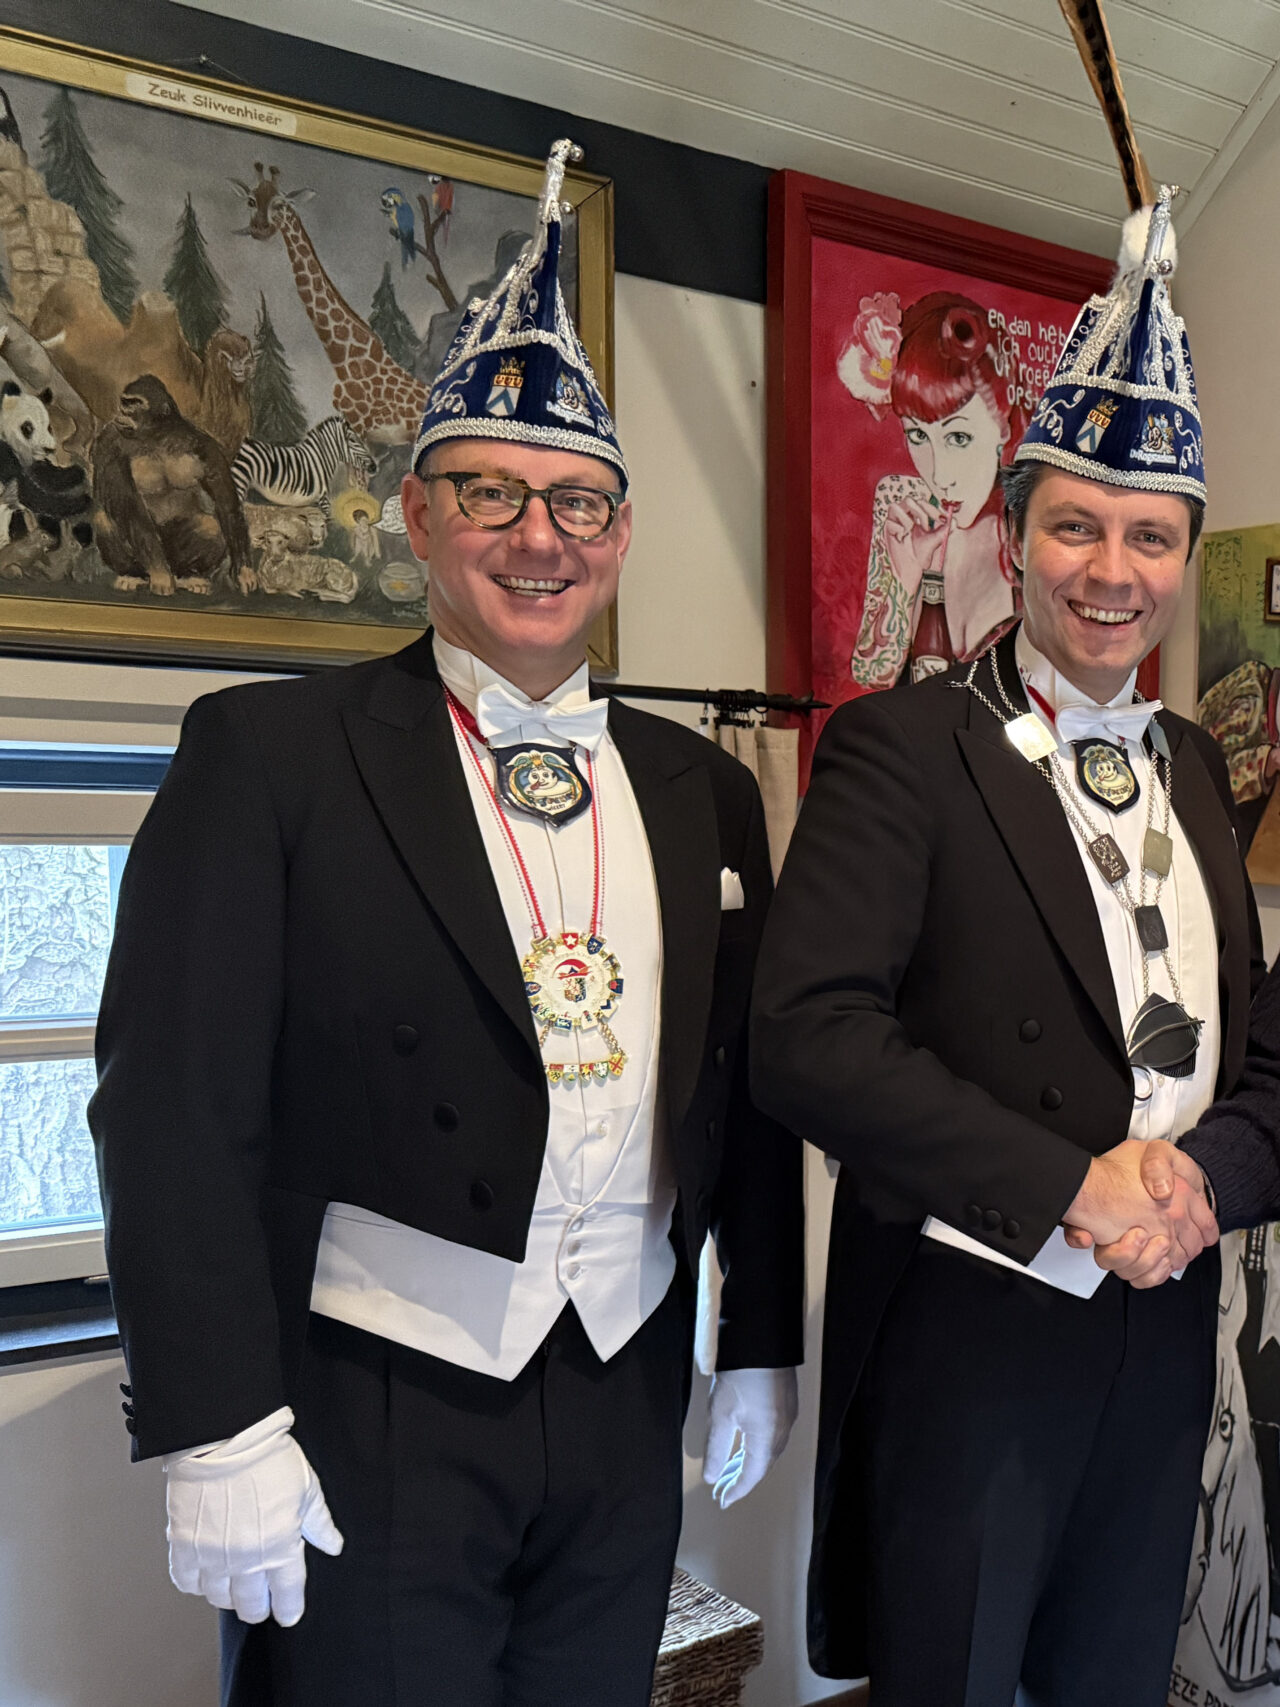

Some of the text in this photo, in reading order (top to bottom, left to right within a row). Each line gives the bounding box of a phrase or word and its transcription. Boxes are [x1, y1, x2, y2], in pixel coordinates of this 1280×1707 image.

[148, 82, 186, 102] Zeuk
[988, 308, 1006, 330] en
[1008, 316, 1031, 338] dan
